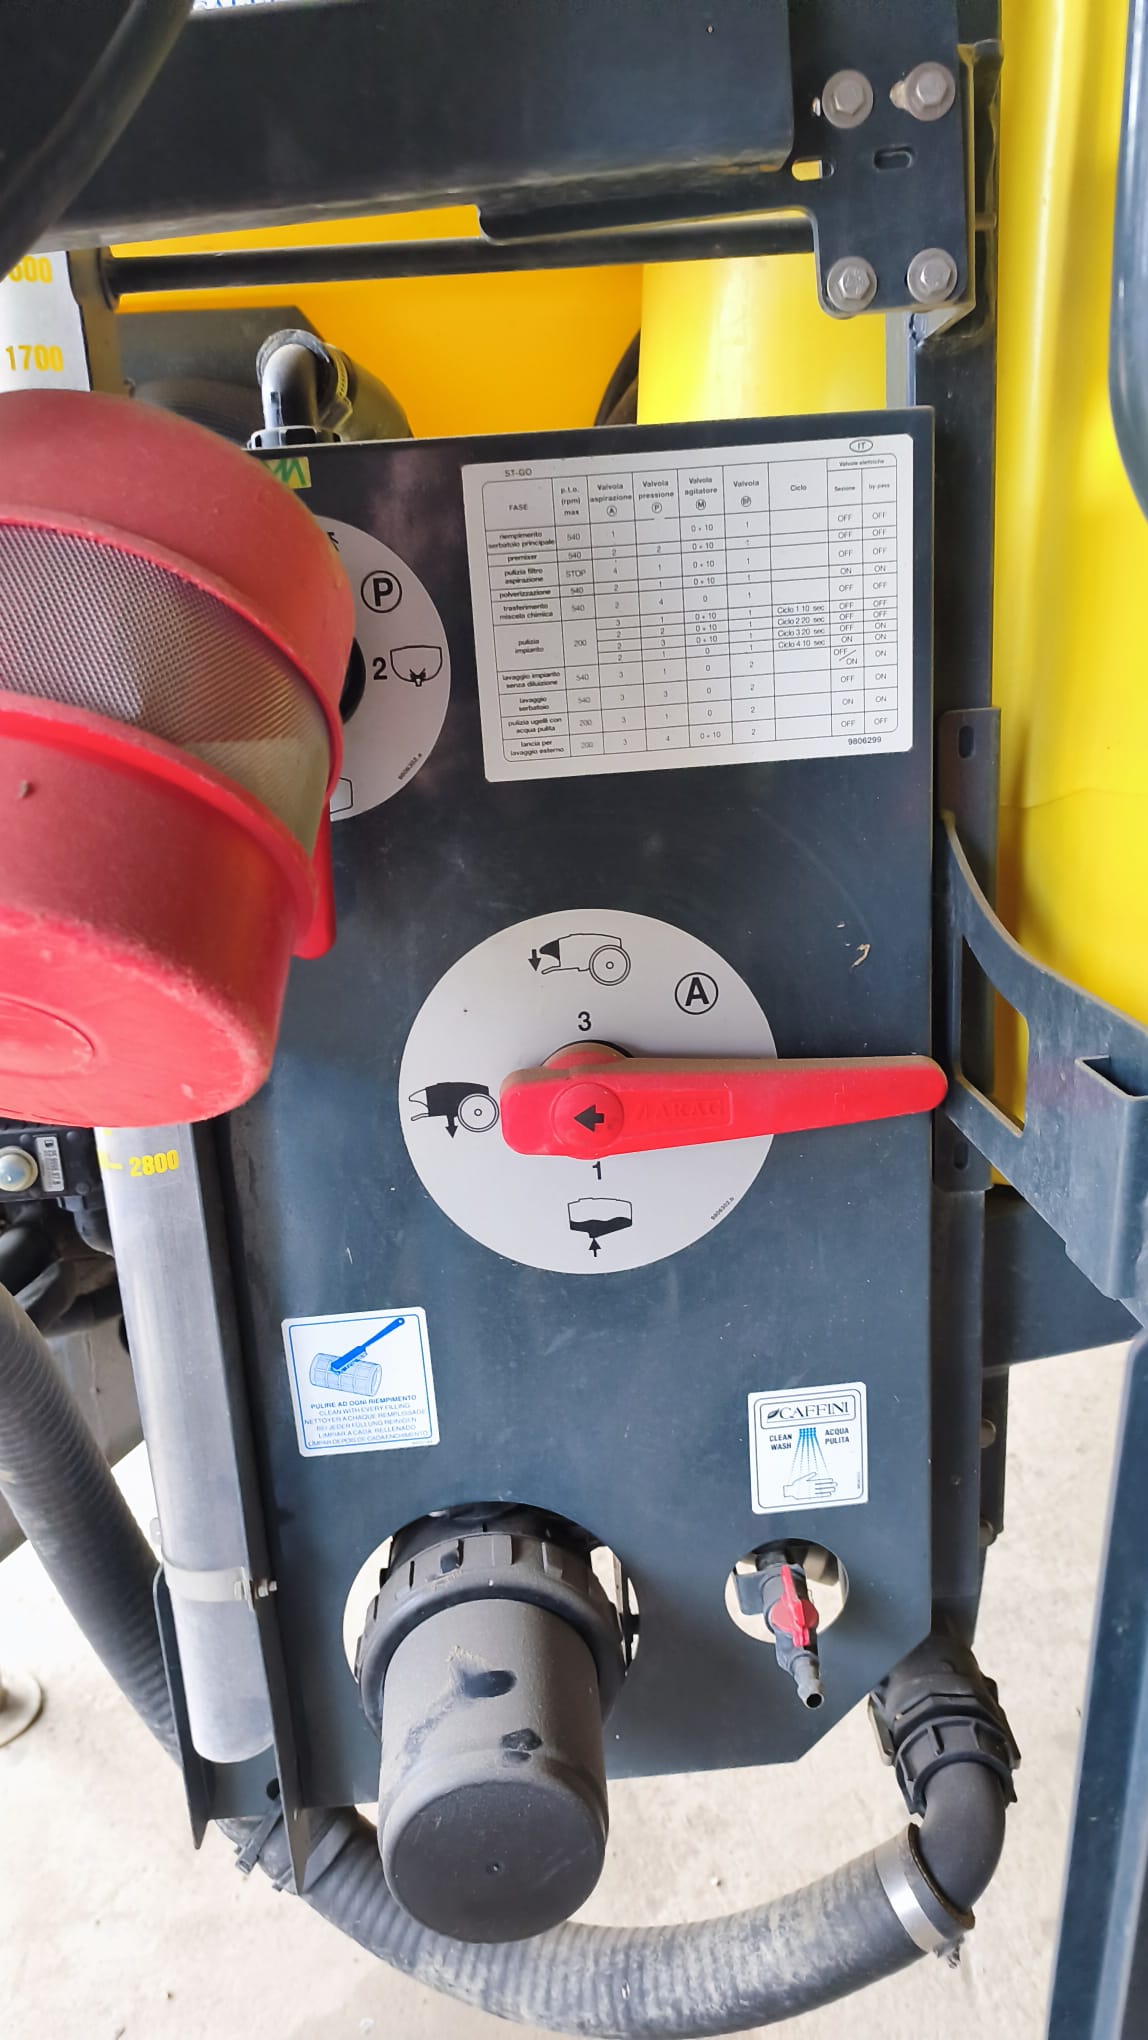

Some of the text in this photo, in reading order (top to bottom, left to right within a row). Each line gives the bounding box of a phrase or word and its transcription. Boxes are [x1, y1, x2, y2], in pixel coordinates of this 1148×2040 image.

[5, 345, 64, 372] 1700
[857, 441, 866, 450] IT
[504, 468, 532, 477] ST-GO
[597, 483, 624, 491] Valvola
[642, 480, 669, 488] Valvola
[733, 480, 759, 488] Valvola
[790, 484, 807, 492] Ciclo
[638, 492, 674, 500] pressione
[685, 488, 718, 496] agitatore
[561, 497, 581, 506] (rpm)
[589, 495, 632, 504] aspirazione
[838, 514, 852, 522] OFF
[872, 512, 885, 520] OFF
[838, 531, 852, 539] OFF
[872, 528, 886, 537] OFF
[567, 533, 581, 541] 540
[568, 551, 582, 560] 540
[838, 549, 853, 558] OFF
[873, 547, 887, 556] OFF
[874, 565, 886, 573] ON
[566, 569, 586, 578] STOP
[839, 584, 853, 592] OFF
[873, 582, 887, 590] OFF
[373, 577, 394, 607] P
[570, 587, 584, 595] 540
[571, 604, 585, 612] 540
[839, 602, 854, 610] OFF
[873, 600, 887, 608] OFF
[777, 606, 794, 614] Ciclo
[873, 610, 888, 618] OFF
[778, 618, 795, 626] Ciclo
[801, 616, 810, 624] 20
[839, 613, 854, 621] OFF
[840, 624, 853, 632] OFF
[875, 621, 886, 630] ON
[778, 628, 795, 637] Ciclo
[801, 628, 811, 636] 20
[874, 633, 887, 641] ON
[778, 640, 795, 648] Ciclo
[834, 648, 848, 656] OFF
[875, 650, 887, 658] ON
[372, 657, 388, 680] 2
[576, 673, 589, 681] 540
[841, 675, 854, 683] OFF
[842, 698, 854, 706] ON
[579, 719, 593, 727] 200
[841, 720, 856, 728] OFF
[874, 717, 888, 725] OFF
[847, 735, 882, 746] 9806299
[684, 976, 711, 1008] A
[578, 1011, 592, 1032] 3
[129, 1149, 180, 1177] 2800
[592, 1161, 602, 1180] 1
[368, 1394, 417, 1405] RIEMPIMENTO
[318, 1408, 342, 1416] CLEAN
[780, 1401, 849, 1419] CAFFINI
[825, 1427, 849, 1436] ACQUA
[769, 1434, 793, 1442] CLEAN
[825, 1436, 850, 1445] PULITA
[771, 1443, 792, 1451] WASH
